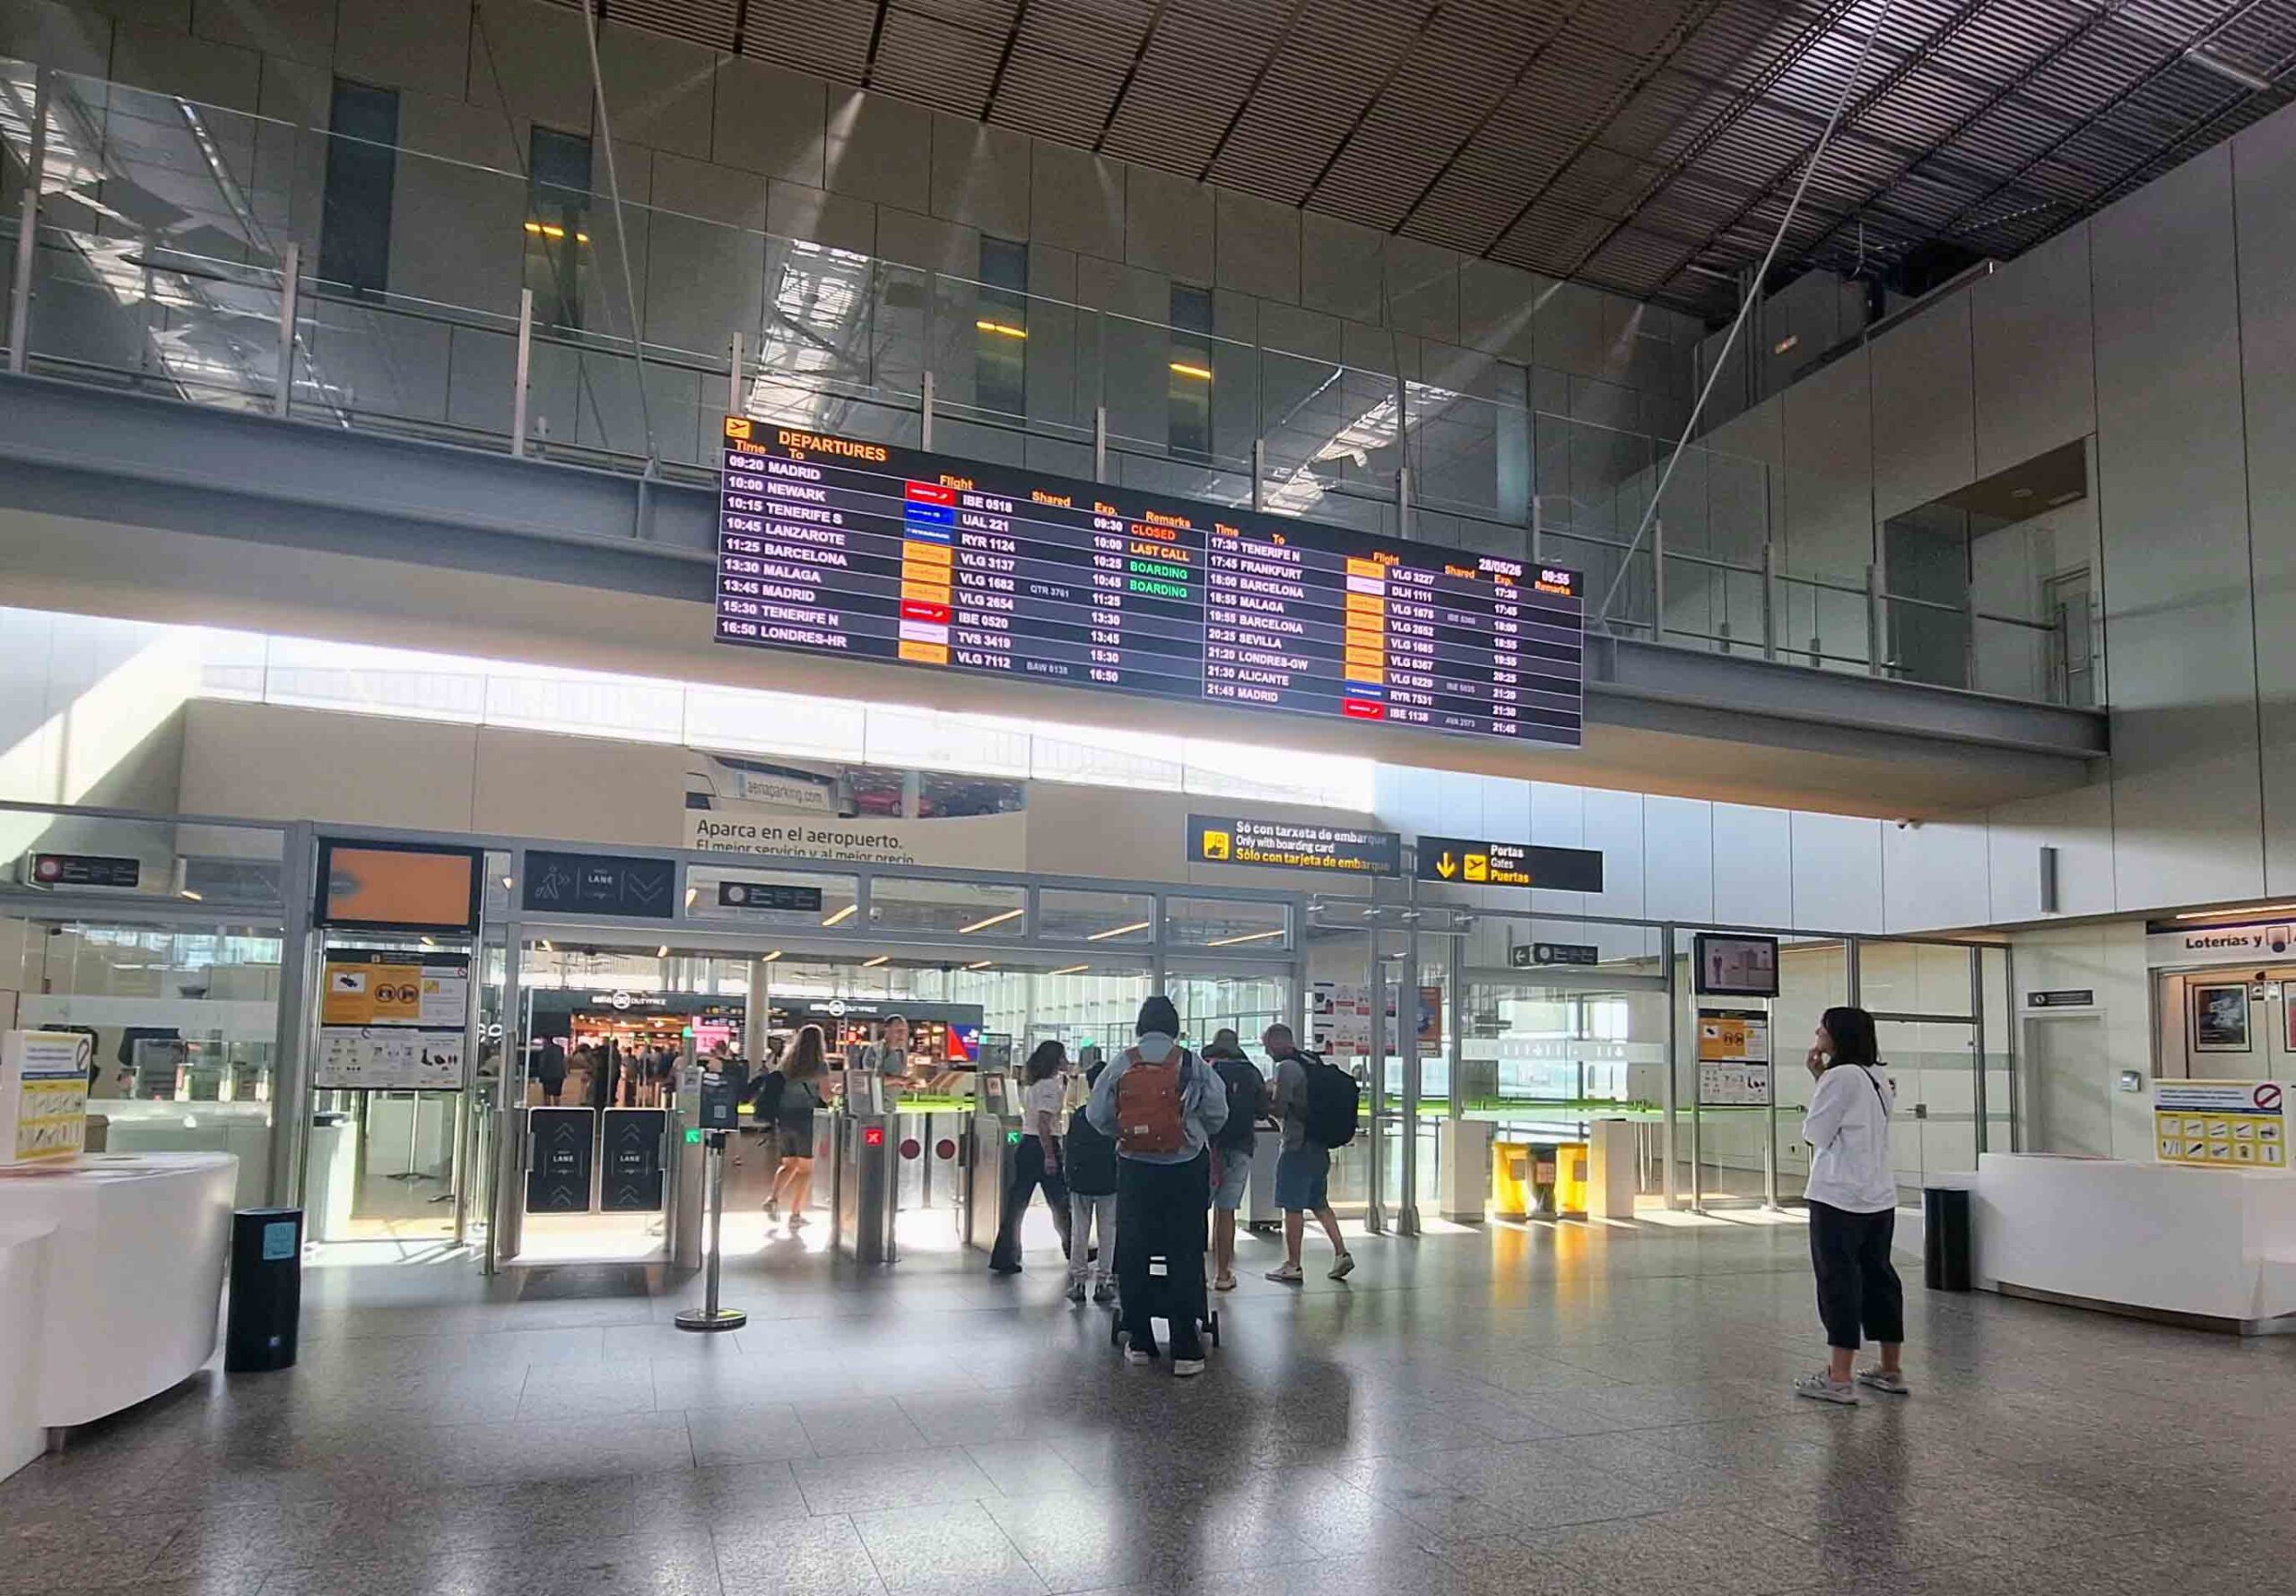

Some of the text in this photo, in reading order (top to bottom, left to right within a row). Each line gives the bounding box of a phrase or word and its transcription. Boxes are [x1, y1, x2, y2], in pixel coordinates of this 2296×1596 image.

[778, 431, 887, 461] DEPARTURES
[730, 455, 1176, 541] 09:20 MADRID IBE 0518 09:30 CLOSED
[735, 440, 1191, 527] Time To Flight Shared Exp. Remarks
[727, 497, 1187, 579] 10:15 TENERIFE S RYR 1124 10:25 BOARDING
[728, 476, 1189, 561] 10:00 NEWARK UAL 221 10:00 LAST CALL
[726, 517, 761, 533] 10:45
[765, 523, 845, 545] LANZAROTE
[961, 553, 986, 567] VLG
[987, 557, 1014, 571] 3137
[1092, 574, 1121, 587] 10:45
[1130, 580, 1187, 598] BOARDING
[1211, 537, 1237, 551] 17:30
[1241, 542, 1291, 560] TENERIFE
[1292, 551, 1300, 562] N
[1392, 568, 1412, 581] VLG
[1214, 524, 1239, 537] Time
[1272, 533, 1285, 545] To
[1373, 552, 1400, 566] Flight
[725, 559, 759, 574] 13:30
[763, 564, 821, 582] MALAGA
[959, 592, 984, 605] VLG
[986, 596, 1013, 611] 2654
[1091, 612, 1120, 626] 13:30
[726, 538, 760, 553] 11:25
[764, 543, 847, 566] BARCELONA
[960, 572, 985, 585] VLG
[987, 577, 1014, 591] 1682
[1091, 593, 1121, 607] 11:25
[1211, 556, 1237, 569] 17:45
[1240, 560, 1302, 580] FRANKFURT
[1392, 585, 1412, 599] DLH
[1413, 590, 1432, 603] 1111
[724, 579, 1120, 645] 13:45 MADRID IBE 0520 13:45
[1210, 592, 1237, 605] 18:55
[1240, 597, 1284, 613] MALAGA
[1391, 620, 1411, 633] VLG
[1211, 574, 1237, 587] 18:00
[1240, 579, 1304, 599] BARCELONA
[1391, 603, 1411, 615] VLG
[723, 601, 756, 615] 15:30
[761, 605, 826, 624] TENERIFE
[828, 615, 839, 626] N
[957, 632, 982, 645] TVS
[1090, 649, 1119, 664] 15:30
[1209, 629, 1236, 642] 20:25
[1239, 633, 1283, 649] SEVILLA
[1390, 655, 1411, 668] VLG
[1210, 610, 1236, 623] 19:55
[1239, 615, 1303, 635] BARCELONA
[1391, 638, 1411, 651] VLG
[722, 621, 755, 636] 16:50
[761, 626, 847, 647] LONDRES-HR
[957, 652, 983, 664] VLG
[984, 655, 1011, 669] 7112
[1090, 668, 1118, 682] 16:50
[1208, 647, 1235, 660] 21:20
[1239, 652, 1308, 671] LONDRES-GW
[1390, 672, 1411, 686] VLG
[1208, 665, 1235, 679] 21:30
[1238, 670, 1289, 686] ALICANTE
[1390, 690, 1411, 703] RYR
[1207, 683, 1234, 697] 21:45
[1238, 688, 1278, 702] MADRID
[1389, 707, 1406, 719] IBE
[1492, 722, 1516, 734] 21:45
[697, 820, 903, 849] Aparca en el aeropuerto.
[1236, 820, 1251, 834] Só
[1253, 824, 1274, 835] con
[1275, 825, 1317, 839] tarxeta
[1318, 828, 1333, 841] de
[1236, 835, 1335, 854] Only with boarding card
[1491, 844, 1524, 858] Portas
[1236, 848, 1261, 861] Sólo
[1262, 851, 1283, 863] con
[1283, 853, 1321, 867] tarjeta
[1323, 854, 1336, 867] de
[1491, 857, 1514, 869] Gates
[1491, 869, 1528, 883] Puertas
[2186, 934, 2263, 949] Loterías y
